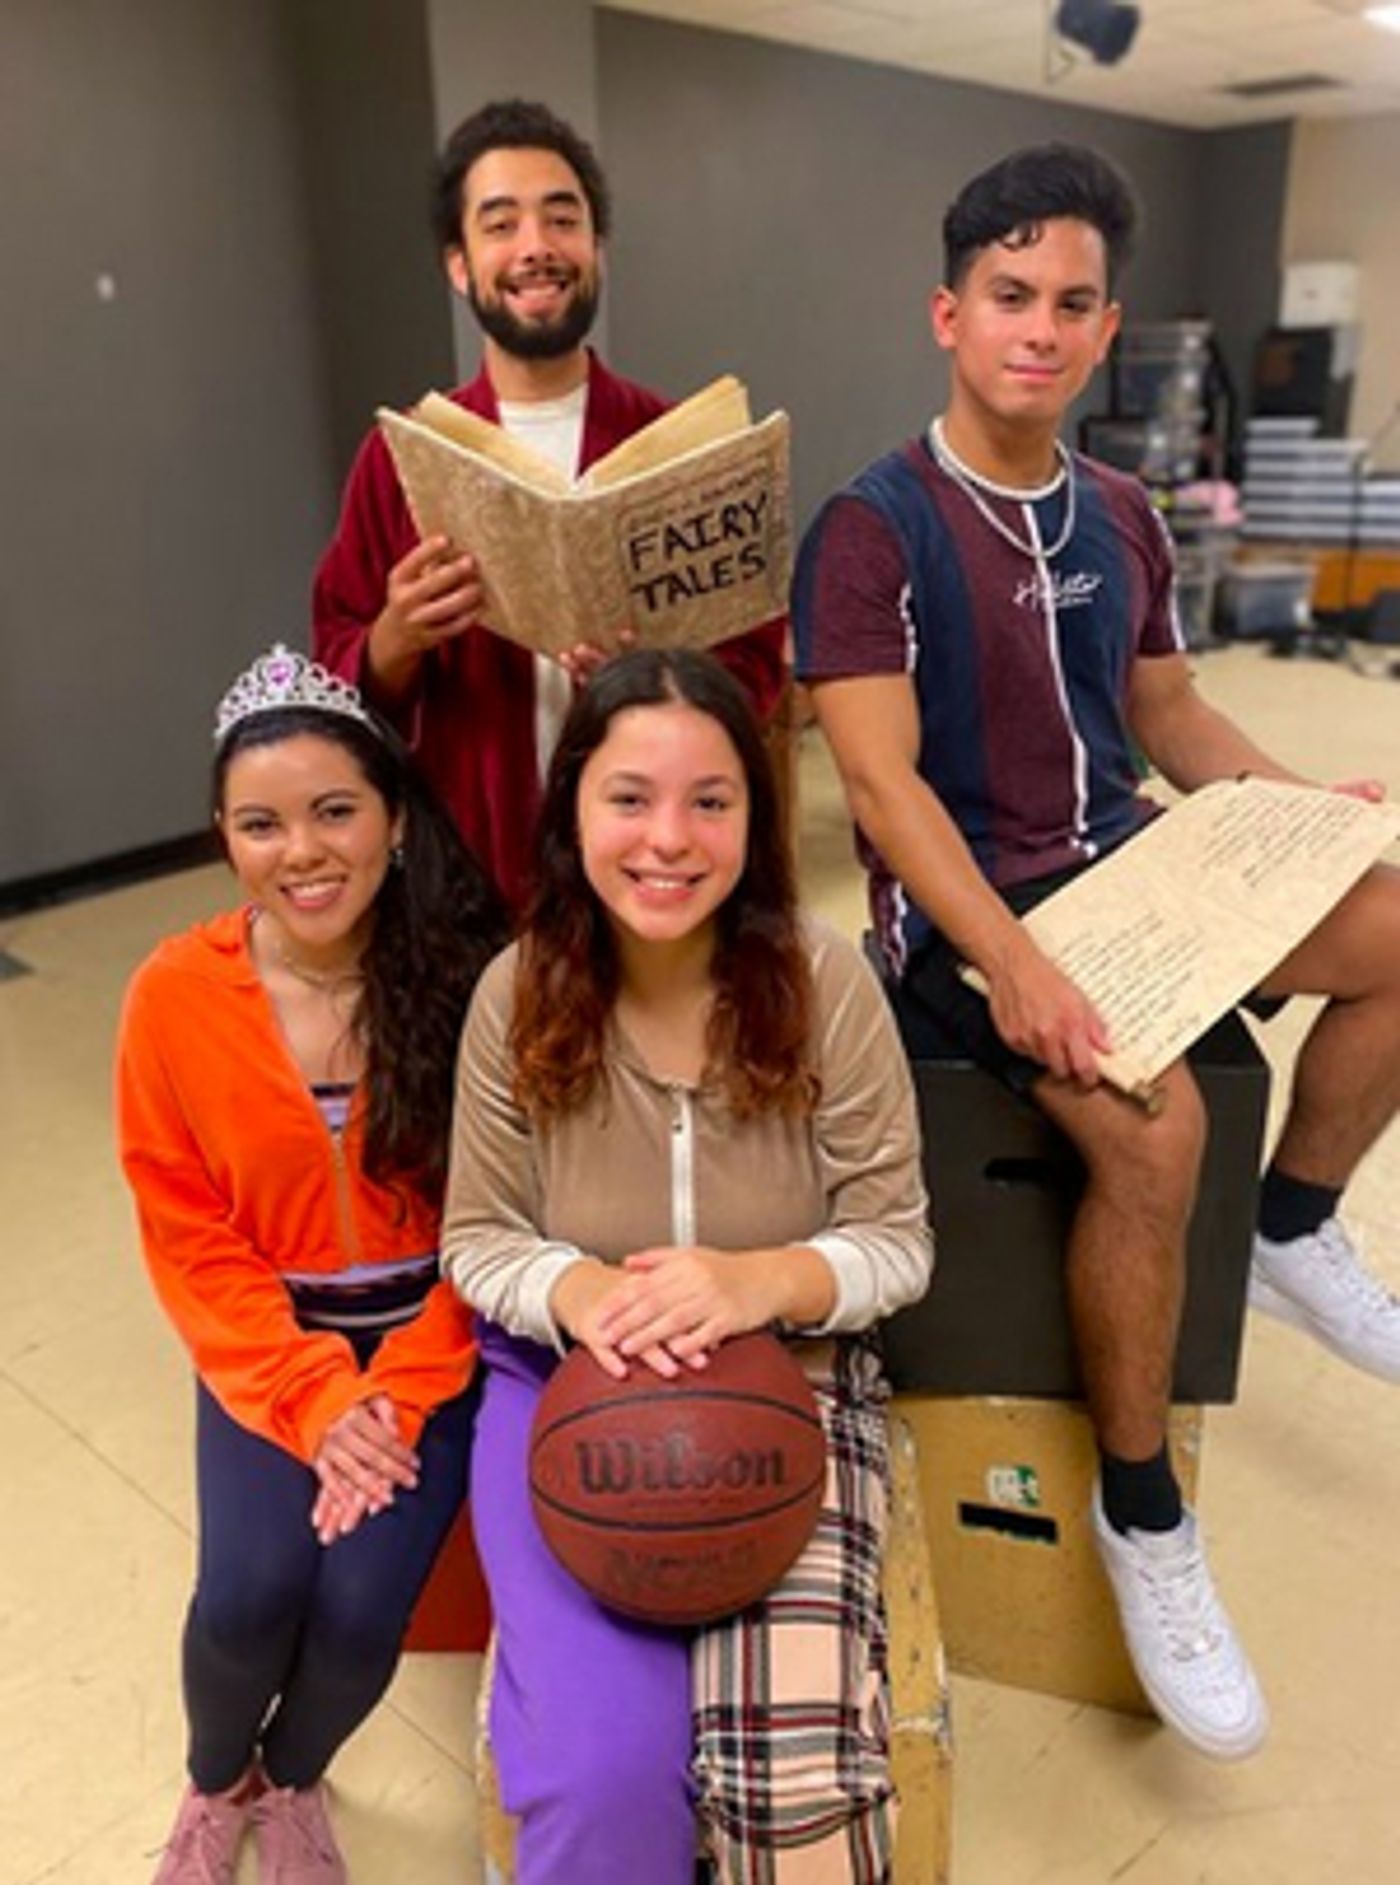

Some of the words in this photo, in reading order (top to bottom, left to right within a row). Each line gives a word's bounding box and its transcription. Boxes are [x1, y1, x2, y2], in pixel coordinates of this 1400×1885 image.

[629, 491, 767, 571] FAIRY
[630, 542, 767, 612] TALES
[577, 1433, 782, 1494] Wilson
